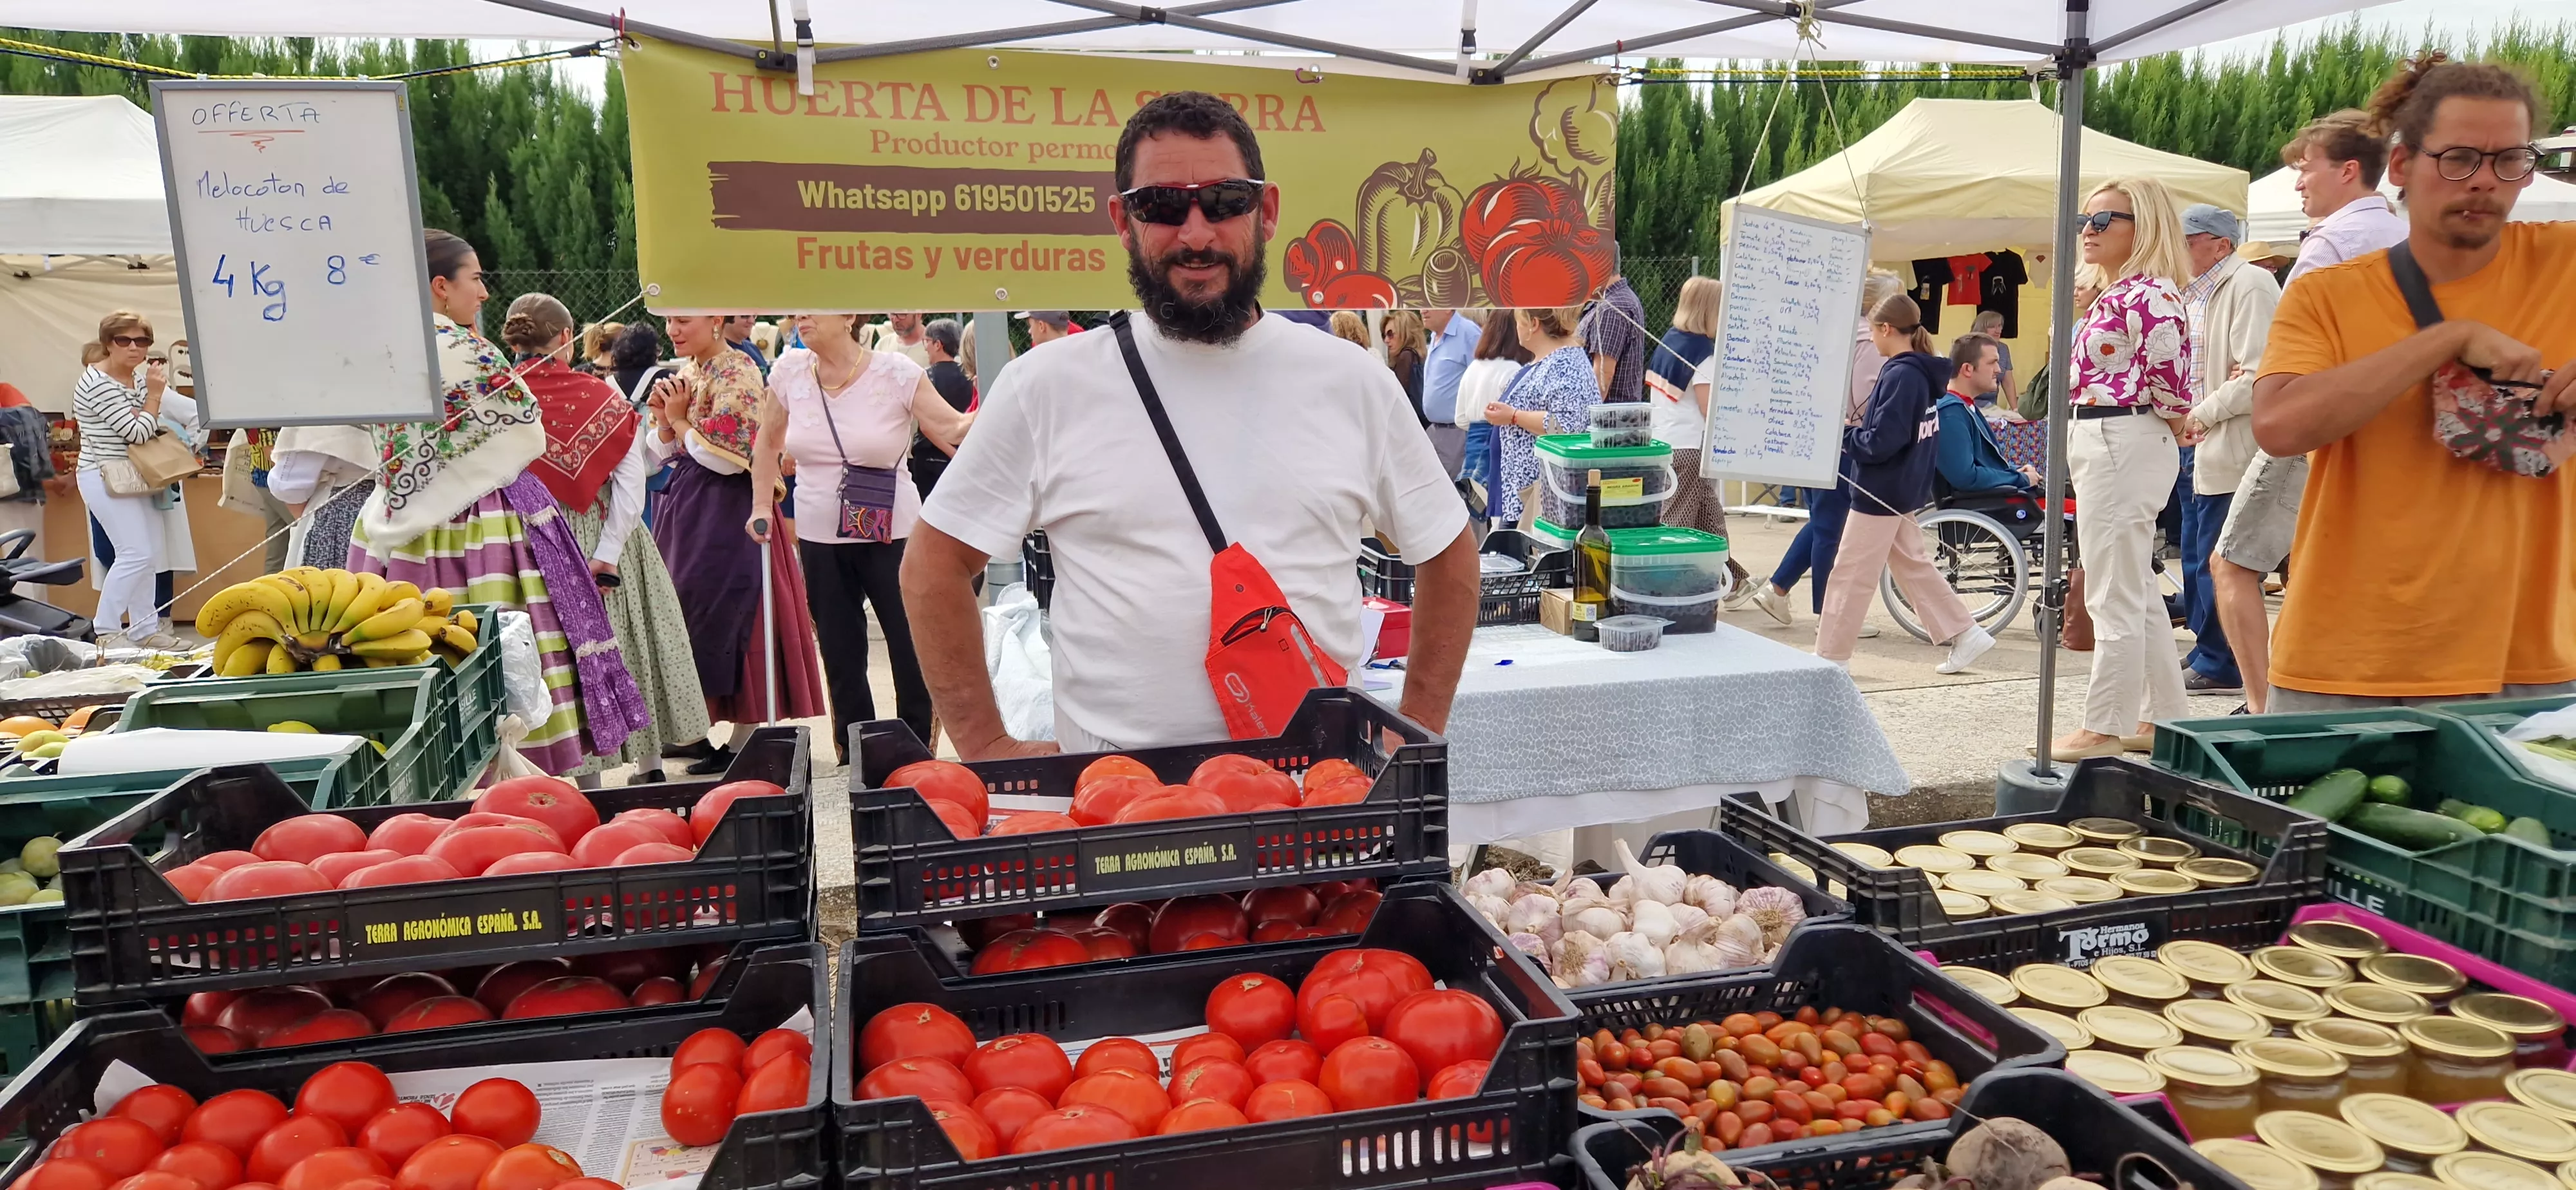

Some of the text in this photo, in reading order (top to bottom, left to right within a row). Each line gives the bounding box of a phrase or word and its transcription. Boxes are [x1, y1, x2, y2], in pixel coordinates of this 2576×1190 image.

[708, 71, 950, 122] HUERTA
[961, 84, 1036, 125] DE
[1049, 86, 1121, 128] LA
[869, 129, 1019, 158] Productor
[196, 170, 350, 199] Melocoton de
[797, 180, 1095, 217] Whatsapp 619501525
[796, 236, 1106, 279] Frutas y verduras
[212, 254, 234, 298] 4
[251, 261, 287, 322] Kg
[1245, 702, 1271, 738] Kalen
[1094, 855, 1121, 875] TERRA
[1125, 845, 1180, 872] AGRONÓMICA
[1221, 844, 1237, 862] S.A.
[2327, 878, 2385, 917] ILLE
[365, 921, 398, 945] TERRA
[403, 912, 472, 941] AGRONÓMICA
[522, 910, 542, 930] S.A.
[2058, 926, 2150, 963] Tormo
[2099, 922, 2146, 934] Hermanos
